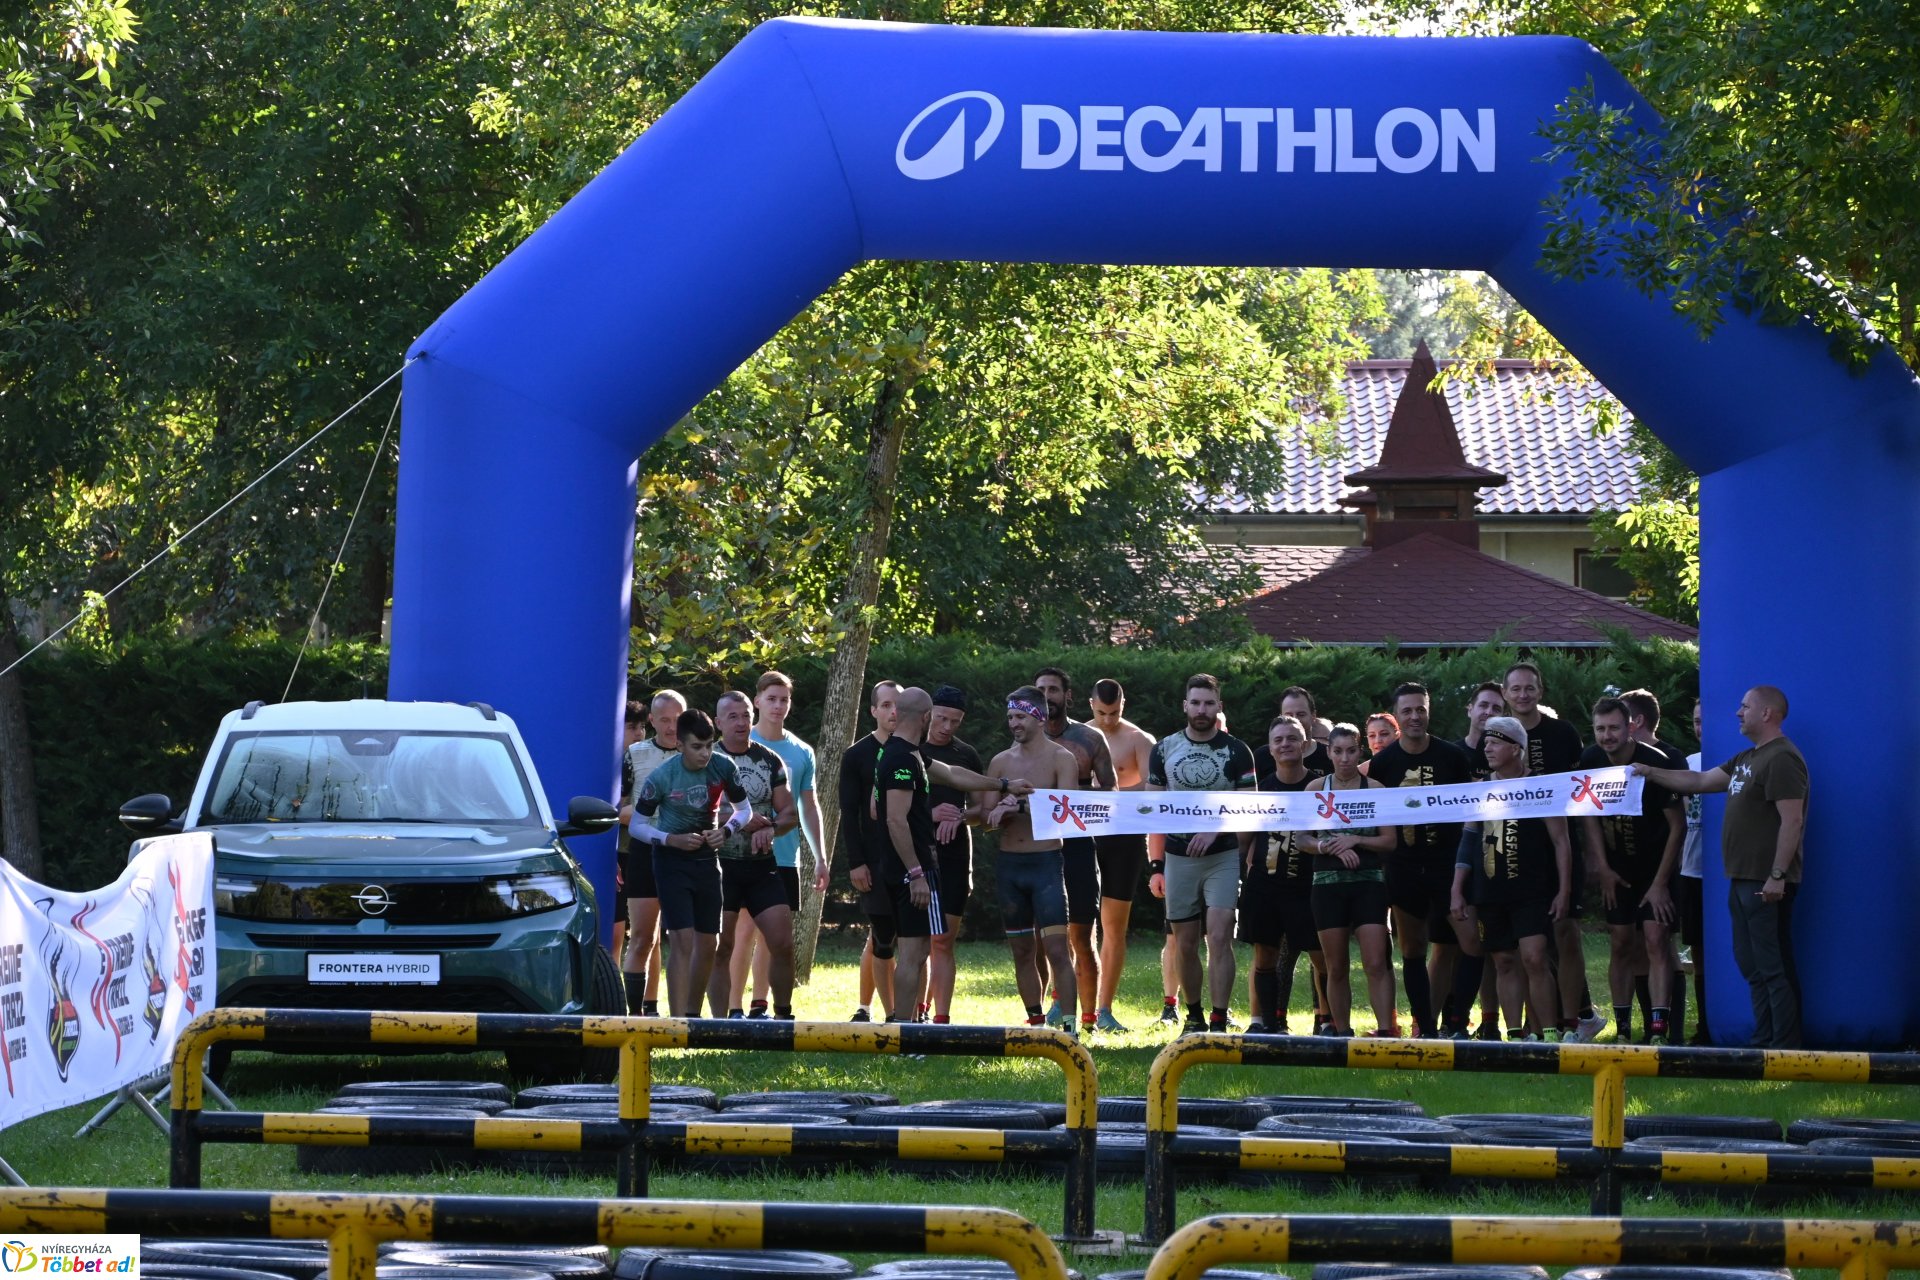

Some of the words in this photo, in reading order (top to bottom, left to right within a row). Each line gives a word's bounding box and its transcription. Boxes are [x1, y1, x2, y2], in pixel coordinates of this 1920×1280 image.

[1020, 103, 1496, 174] DECATHLON
[1427, 794, 1480, 807] Platán
[1486, 788, 1554, 803] Autóház
[1159, 803, 1213, 816] Platán
[1218, 803, 1288, 816] Autóház
[319, 963, 383, 973] FRONTERA
[386, 963, 431, 974] HYBRID
